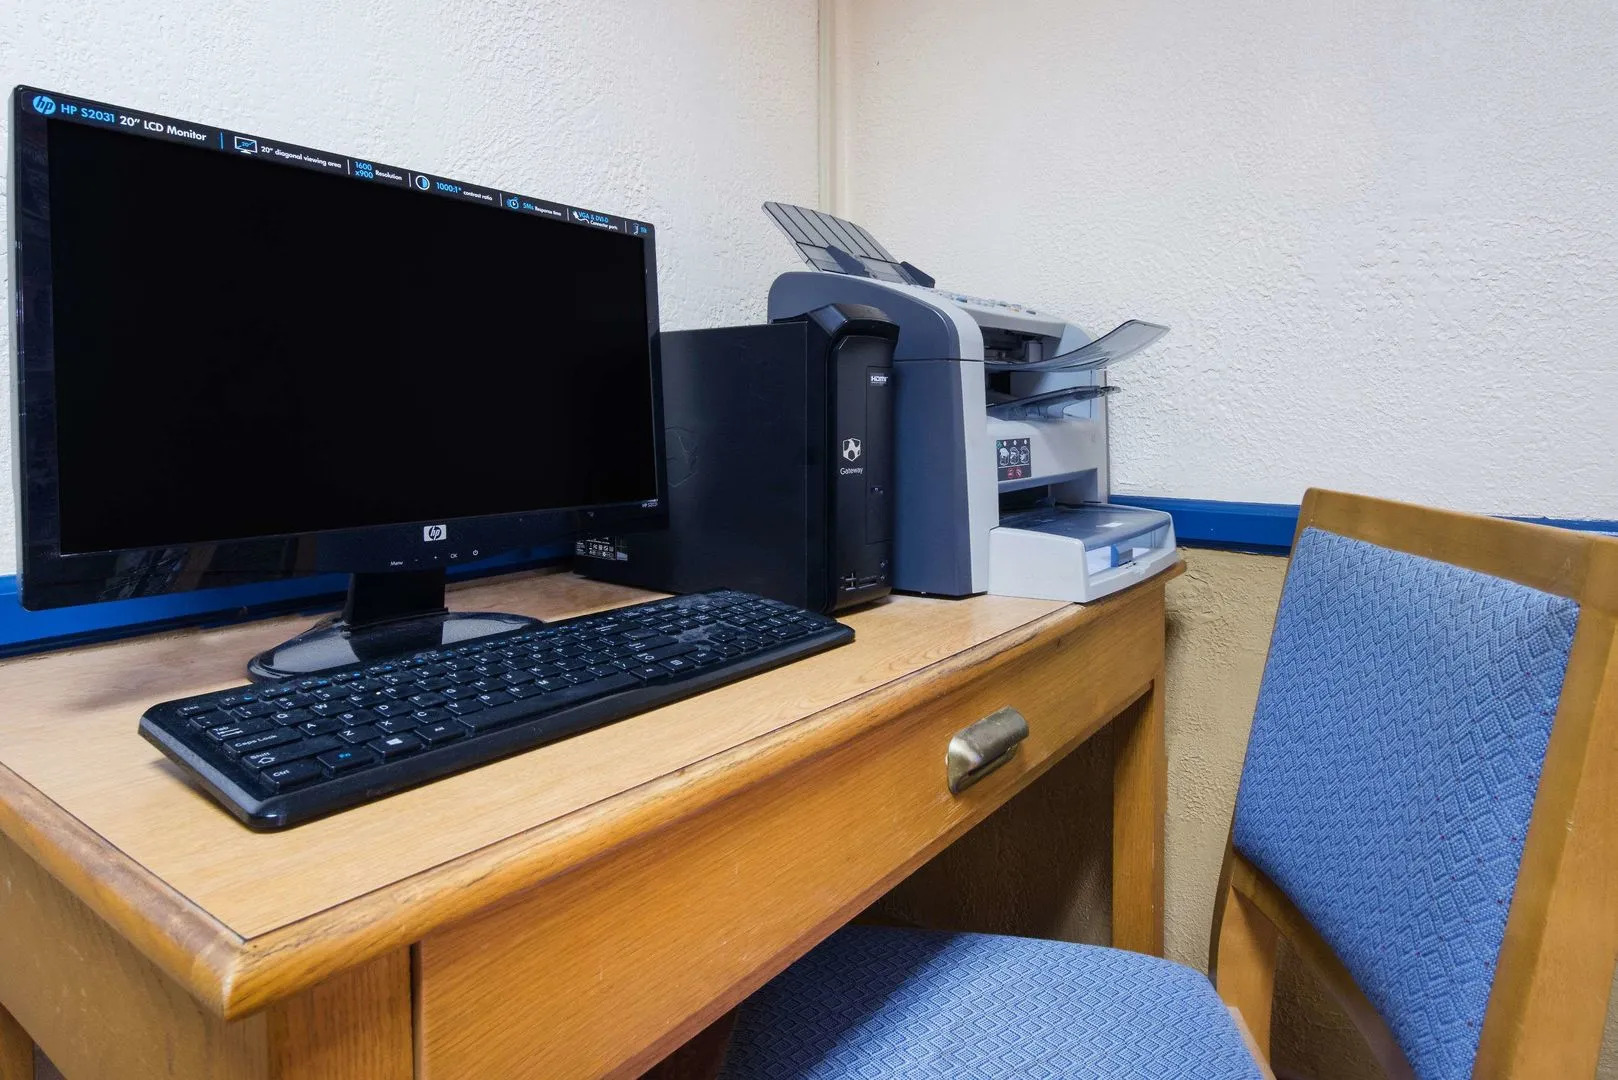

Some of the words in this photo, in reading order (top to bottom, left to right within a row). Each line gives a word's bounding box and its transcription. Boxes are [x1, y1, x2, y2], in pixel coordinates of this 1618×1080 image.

[33, 95, 56, 115] hp
[61, 104, 77, 115] HP
[81, 108, 115, 123] S2031
[144, 121, 164, 132] LCD
[166, 125, 207, 141] Monitor
[275, 149, 302, 161] diagonal
[303, 155, 327, 166] viewing
[328, 161, 342, 169] area
[355, 161, 372, 171] 1600
[355, 169, 374, 179] x900
[375, 170, 403, 181] Resolution
[463, 191, 482, 199] contrast
[579, 212, 590, 220] VGA
[840, 467, 864, 475] Gateway
[234, 740, 257, 748] Caps
[257, 734, 278, 742] Lock
[250, 752, 270, 760] Shift
[273, 769, 290, 777] Ctrl
